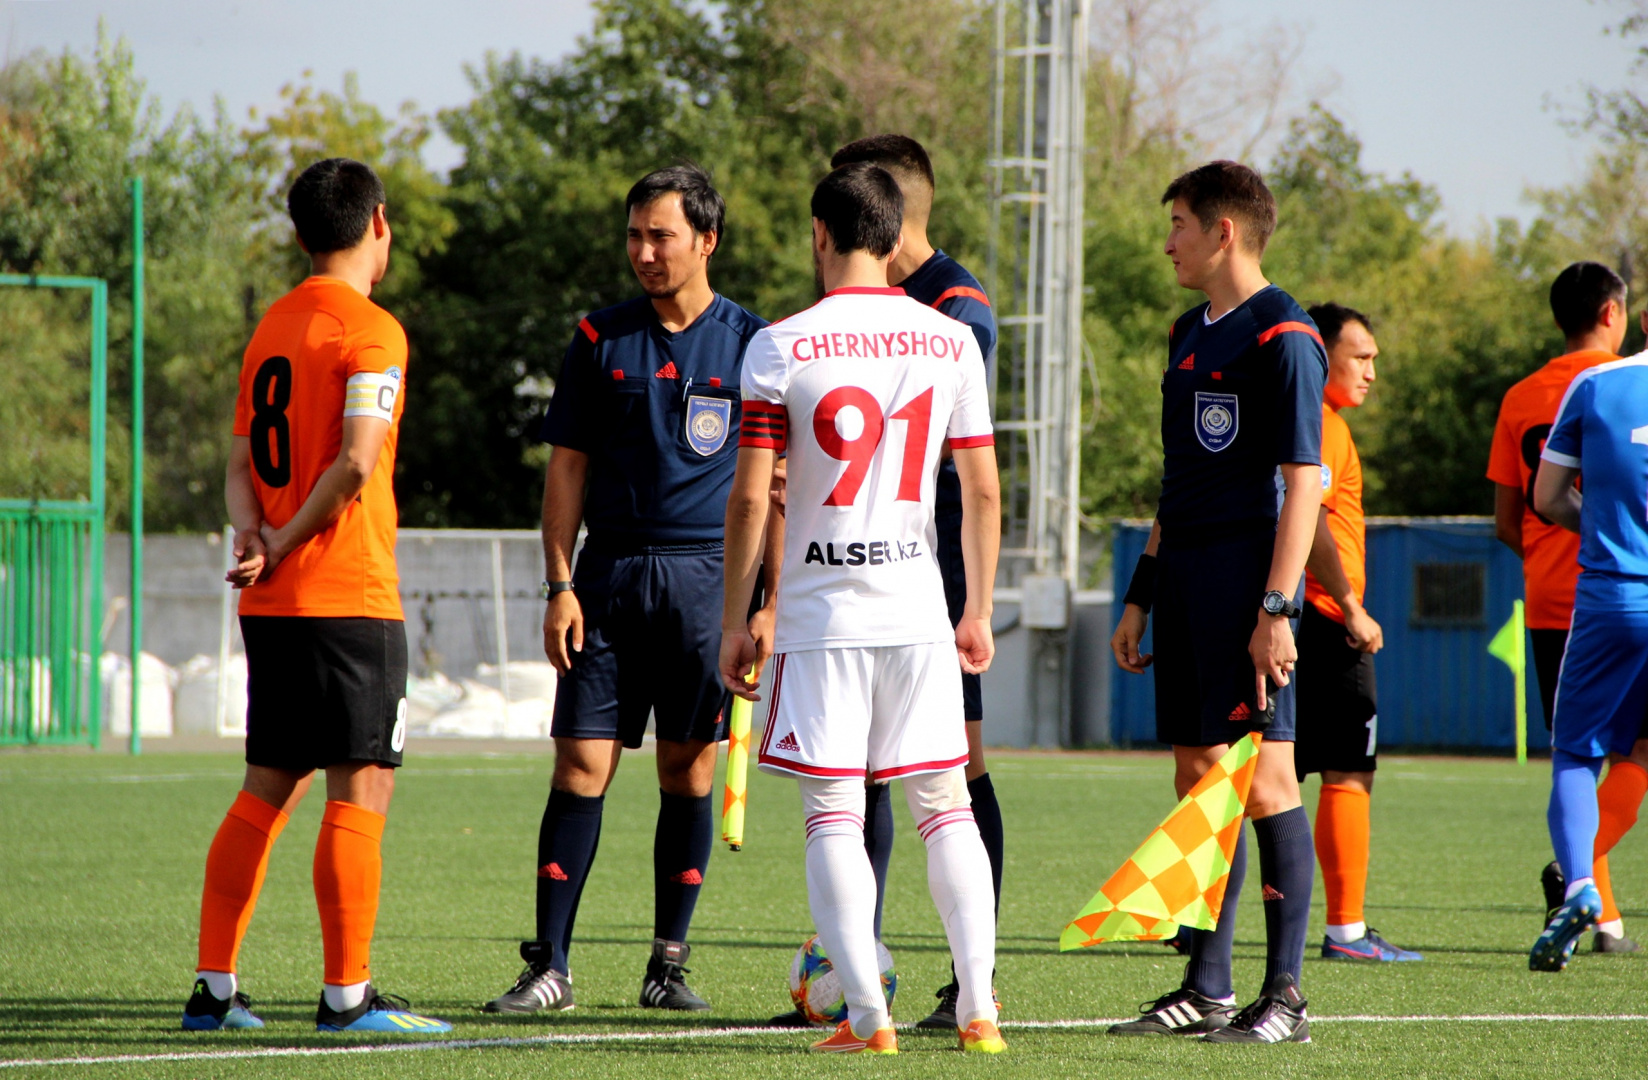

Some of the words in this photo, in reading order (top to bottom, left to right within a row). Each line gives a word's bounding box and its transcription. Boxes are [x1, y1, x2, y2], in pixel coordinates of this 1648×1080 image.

[792, 331, 964, 362] CHERNYSHOV
[377, 385, 395, 412] C
[251, 356, 292, 488] 8
[812, 385, 934, 506] 91
[391, 697, 407, 753] 8
[775, 743, 801, 752] adidas
